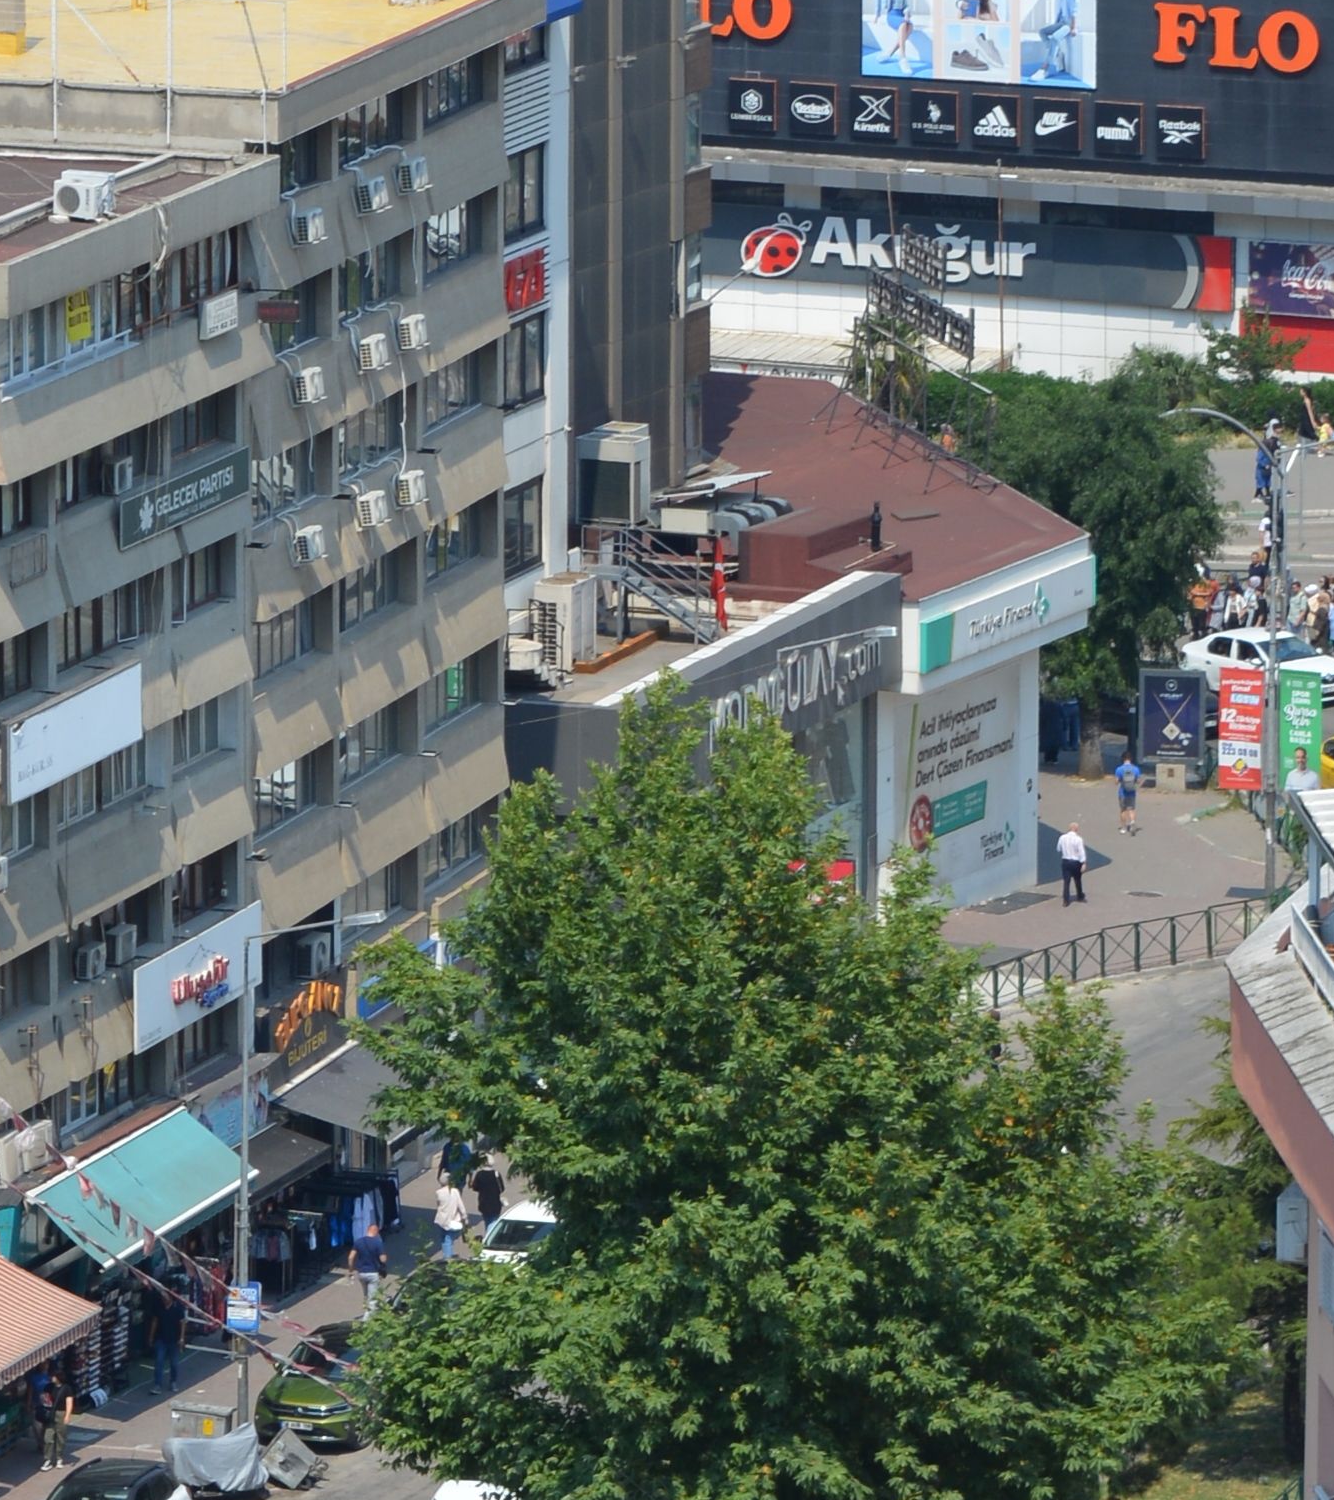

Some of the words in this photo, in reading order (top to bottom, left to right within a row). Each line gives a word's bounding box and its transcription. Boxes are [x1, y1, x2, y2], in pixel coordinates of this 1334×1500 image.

[1154, 1, 1320, 74] FLO
[1041, 111, 1068, 127] NIKE
[973, 125, 1017, 138] adidas
[1097, 124, 1131, 140] PUMA
[155, 481, 199, 517] GELECEK
[199, 464, 234, 498] PARTİSİ
[969, 610, 1003, 639] Türkiye
[1003, 602, 1033, 626] Finans
[920, 718, 937, 740] Acil
[915, 768, 935, 789] Dert
